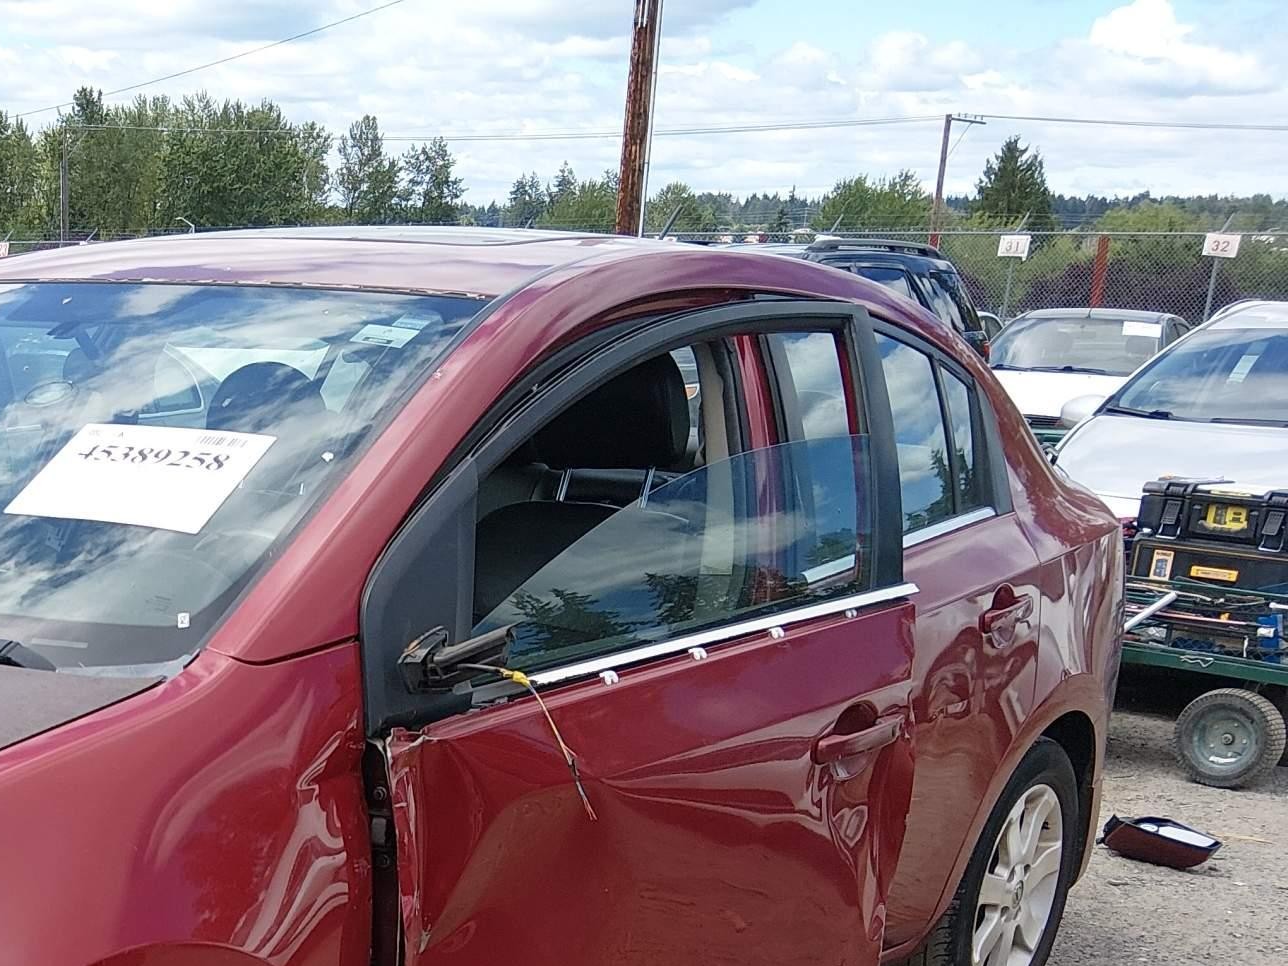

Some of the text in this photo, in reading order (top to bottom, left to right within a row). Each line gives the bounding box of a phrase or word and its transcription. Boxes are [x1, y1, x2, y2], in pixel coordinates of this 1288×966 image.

[1004, 241, 1021, 253] 31
[1210, 239, 1231, 253] 32
[78, 444, 230, 471] 45389258
